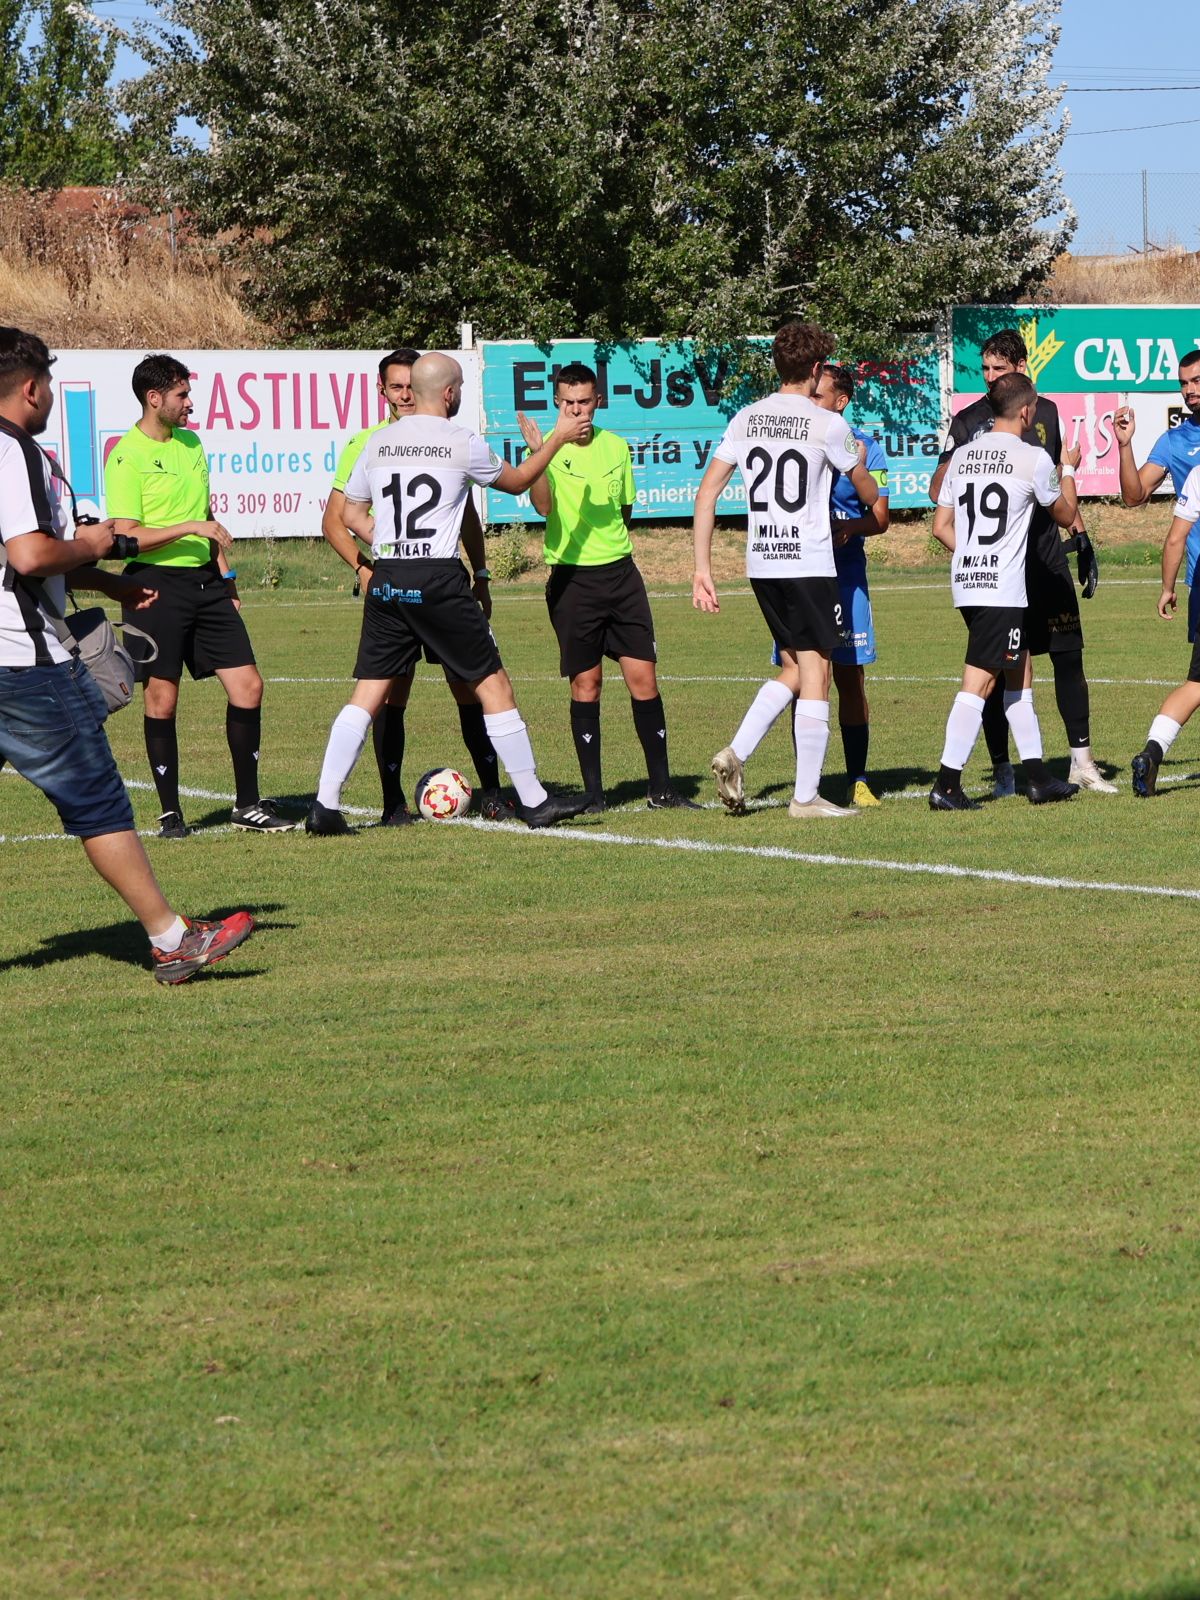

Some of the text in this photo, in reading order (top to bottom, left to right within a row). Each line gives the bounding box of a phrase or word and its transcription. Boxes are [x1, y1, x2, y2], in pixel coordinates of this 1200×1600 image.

[1073, 337, 1180, 384] CAJA
[748, 414, 811, 429] RESTAURANTE
[746, 424, 809, 441] LA MURALLA
[378, 445, 452, 459] ANJIVERFOREX
[694, 439, 713, 470] y
[966, 449, 1008, 461] AUTOS
[958, 457, 1014, 475] CASTAÑO
[745, 446, 809, 513] 20
[237, 492, 266, 514] 309
[273, 492, 302, 514] 807
[382, 473, 442, 540] 12
[958, 482, 1009, 545] 19
[758, 524, 800, 539] MILAR
[771, 542, 802, 552] VERDE
[779, 552, 802, 560] RURAL
[962, 554, 999, 568] MILAR
[970, 571, 999, 582] VERDE
[391, 587, 422, 598] PILAR
[962, 582, 976, 590] CASA
[1008, 627, 1021, 650] 19
